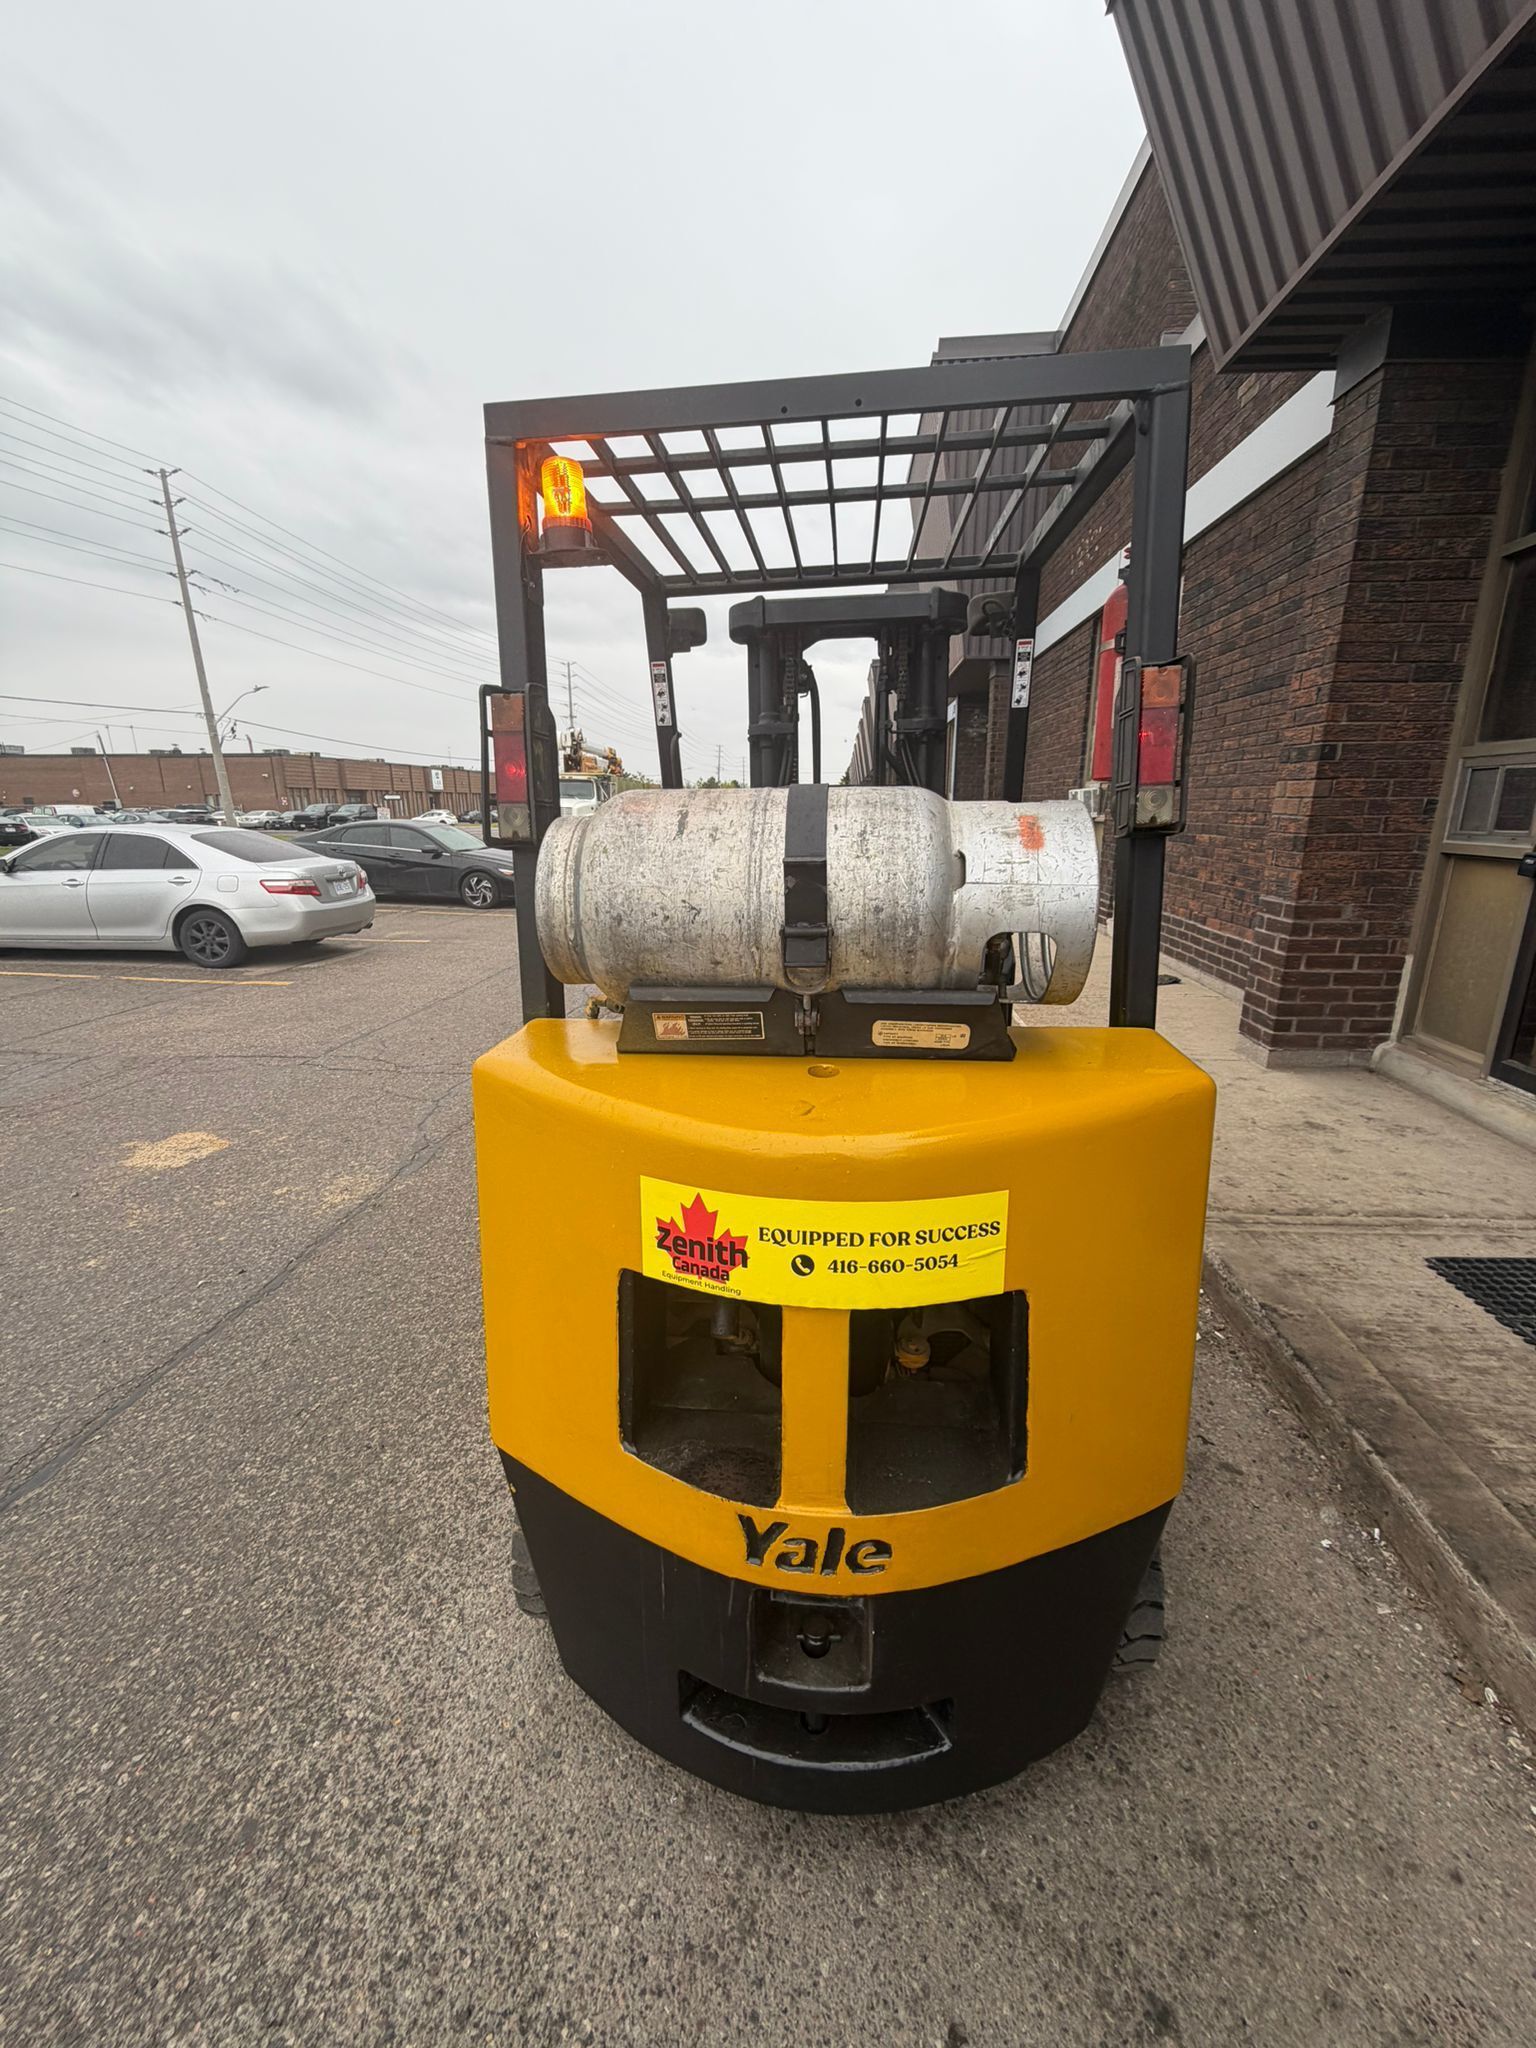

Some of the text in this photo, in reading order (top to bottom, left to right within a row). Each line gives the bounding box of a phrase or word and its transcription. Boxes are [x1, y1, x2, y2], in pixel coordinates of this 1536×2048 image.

[758, 1220, 1001, 1247] EQUIPPED FOR SUCCESS
[656, 1226, 748, 1268] Zenith
[672, 1255, 730, 1281] Canada
[827, 1253, 959, 1274] 416-660-5054
[661, 1270, 742, 1296] Equipment Handling
[736, 1513, 893, 1577] Yale
